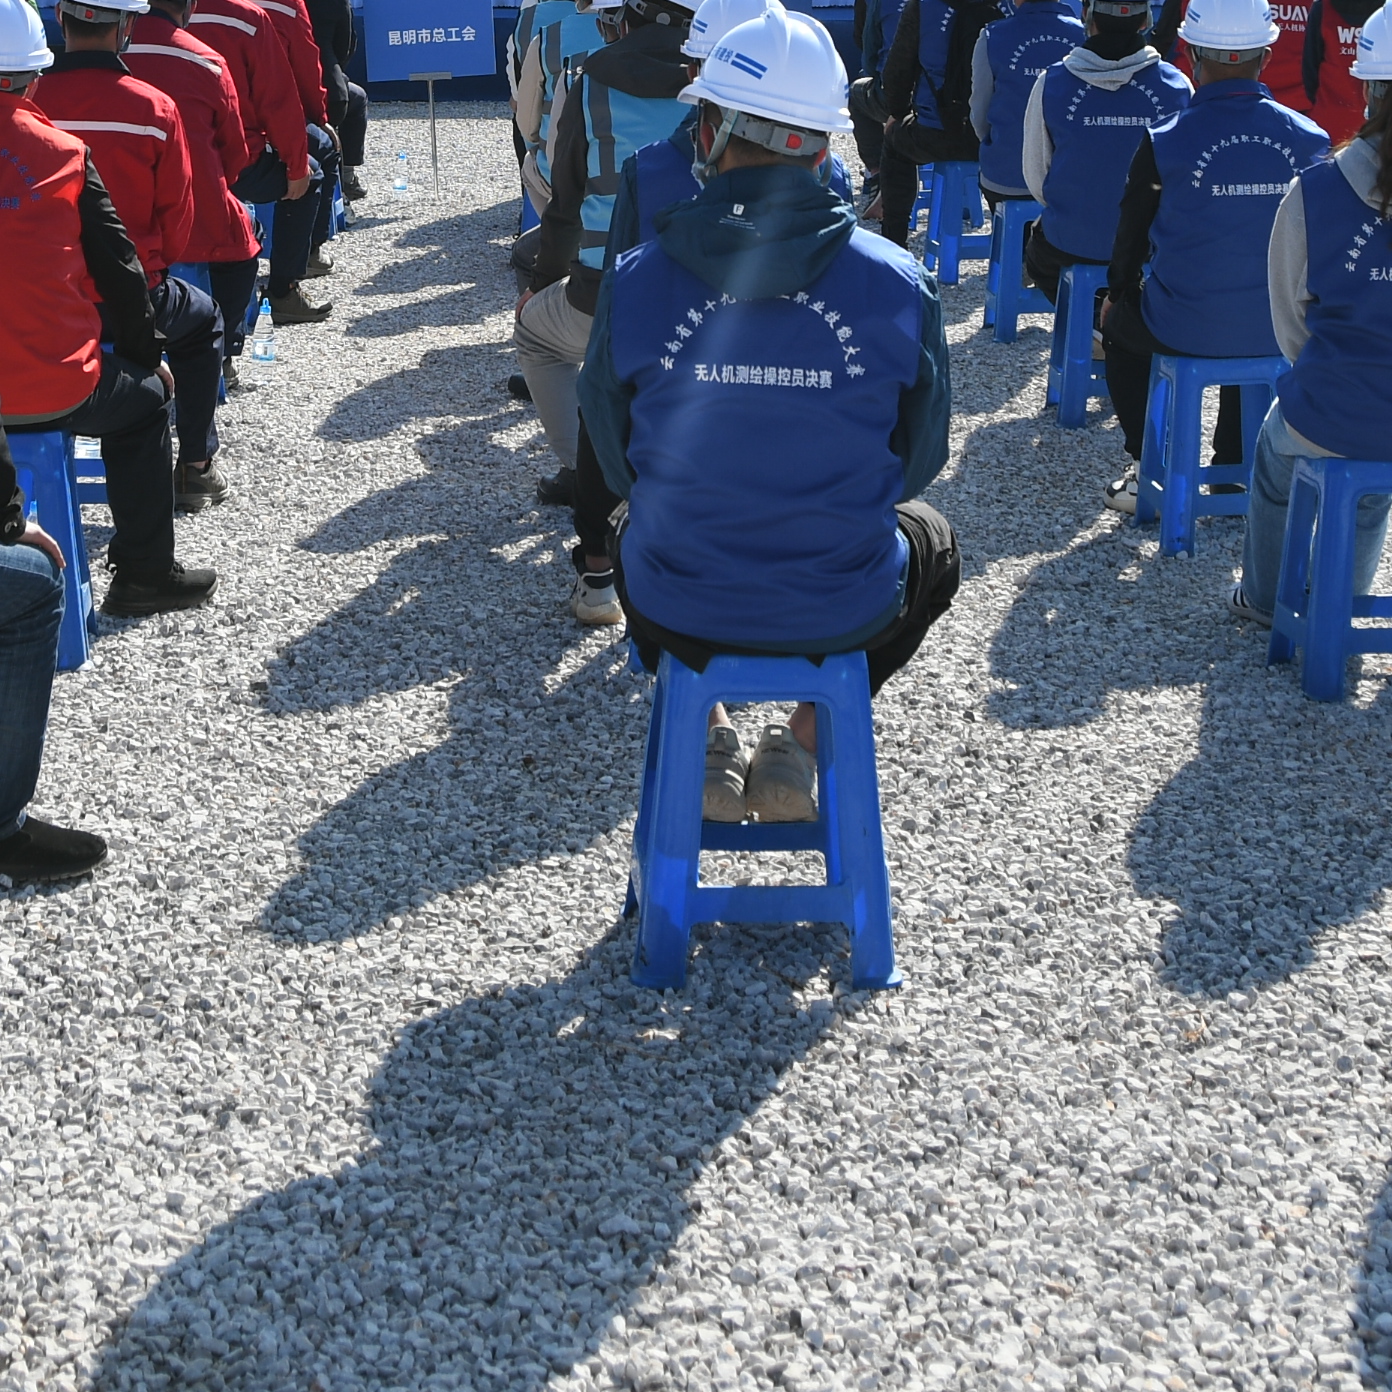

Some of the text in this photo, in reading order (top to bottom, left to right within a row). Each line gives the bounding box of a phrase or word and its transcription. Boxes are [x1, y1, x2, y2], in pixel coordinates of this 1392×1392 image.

[388, 25, 476, 46] 昆明市总工会
[694, 362, 833, 389] 无人机测绘操控员决赛
